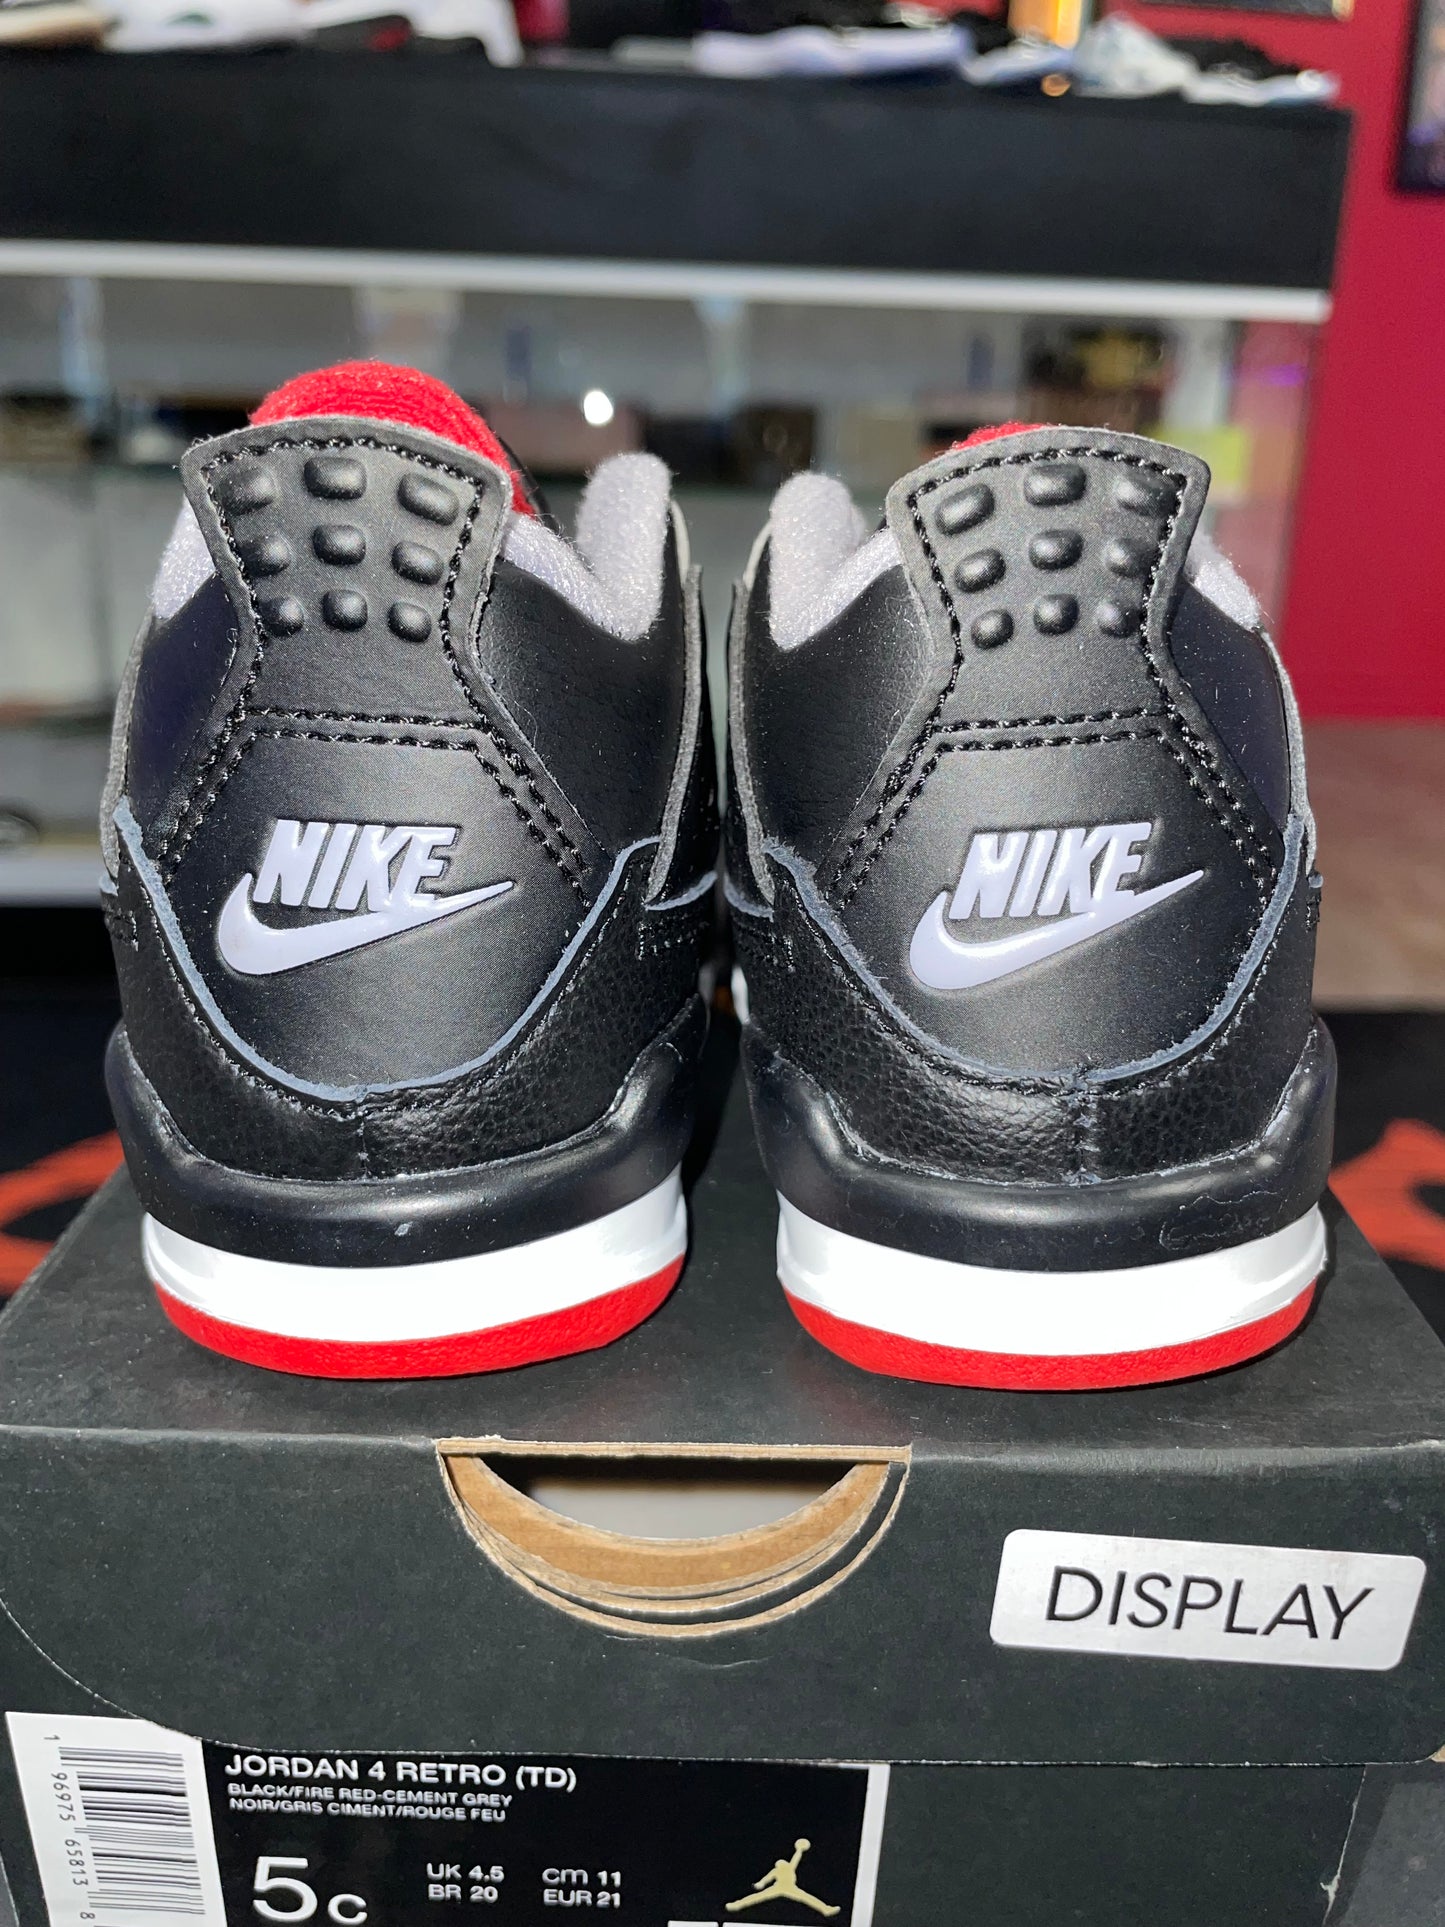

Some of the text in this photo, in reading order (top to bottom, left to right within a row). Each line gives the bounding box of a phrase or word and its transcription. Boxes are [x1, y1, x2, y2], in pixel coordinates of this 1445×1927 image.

[254, 819, 457, 911] NIKE
[949, 822, 1152, 919] NIKE
[1046, 1566, 1375, 1640] DISPLAY
[225, 1754, 577, 1792] JORDAN 4 RETRO (TD)
[228, 1783, 512, 1808] BLACK/FIRE RED-CEMENT GREY
[229, 1798, 506, 1823] NOIR/GRIS CIMENT/ROUGE FEU
[51, 1772, 75, 1821] 96975
[65, 1838, 88, 1886] 65813
[79, 1911, 96, 1920] 8
[426, 1862, 505, 1882] UK 4.5
[597, 1870, 621, 1887] 11
[428, 1884, 499, 1902] BR 20
[543, 1888, 621, 1908] EUR 21
